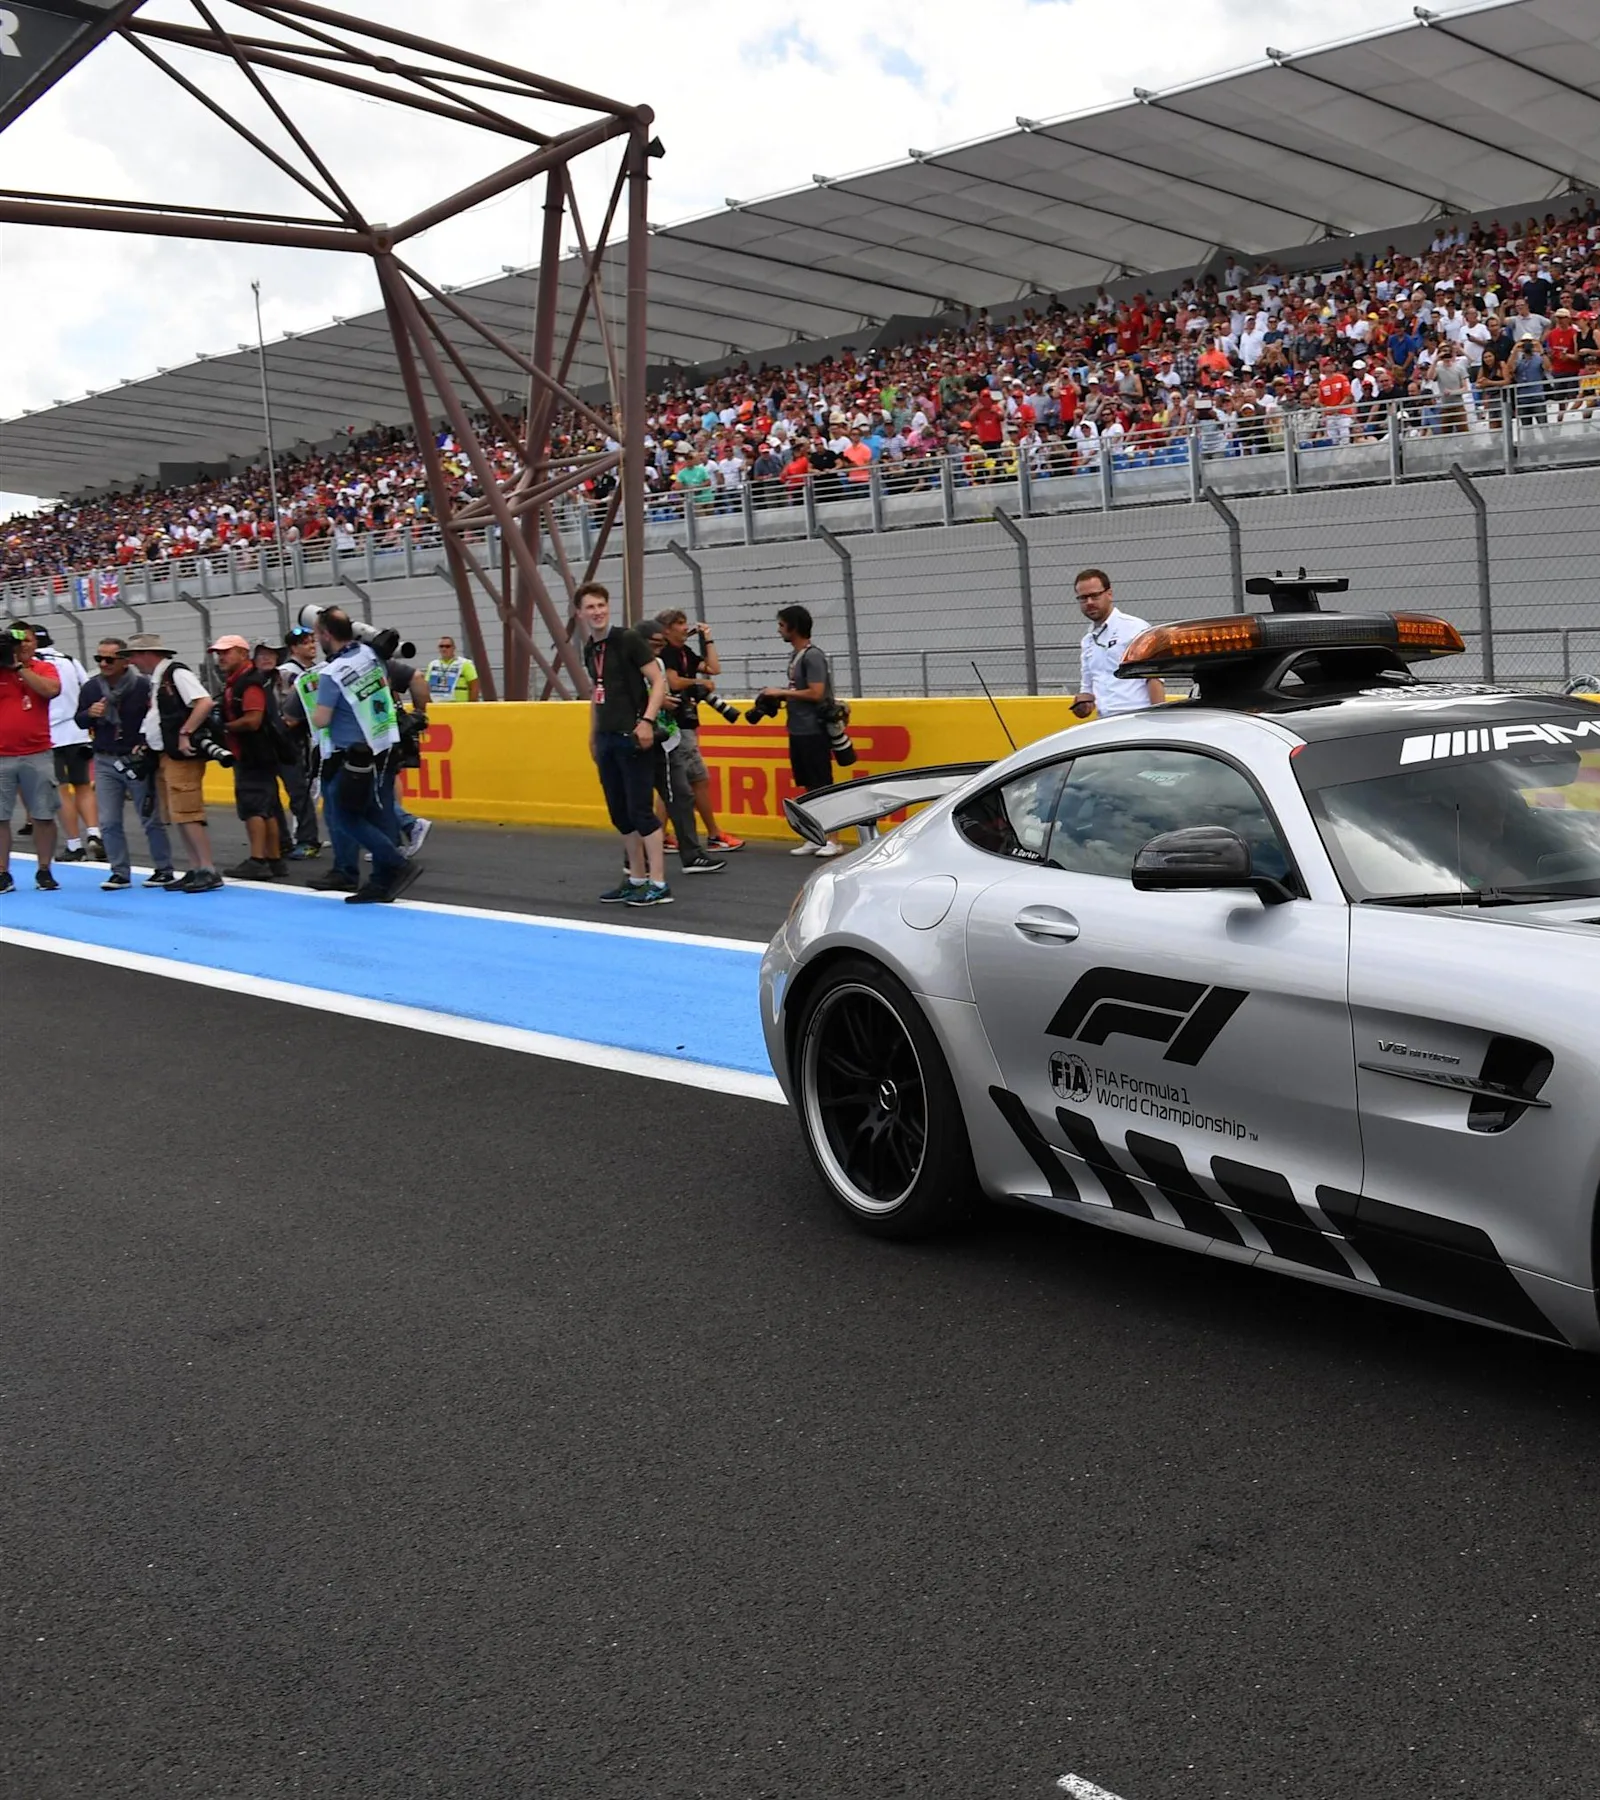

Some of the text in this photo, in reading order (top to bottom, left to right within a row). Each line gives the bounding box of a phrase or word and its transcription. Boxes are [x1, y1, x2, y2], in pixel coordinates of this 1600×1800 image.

[1377, 1038, 1408, 1056] V8
[1095, 1067, 1119, 1089] FIA
[1120, 1074, 1180, 1100] Formula
[1096, 1087, 1138, 1113] World
[1140, 1098, 1247, 1141] Championship
